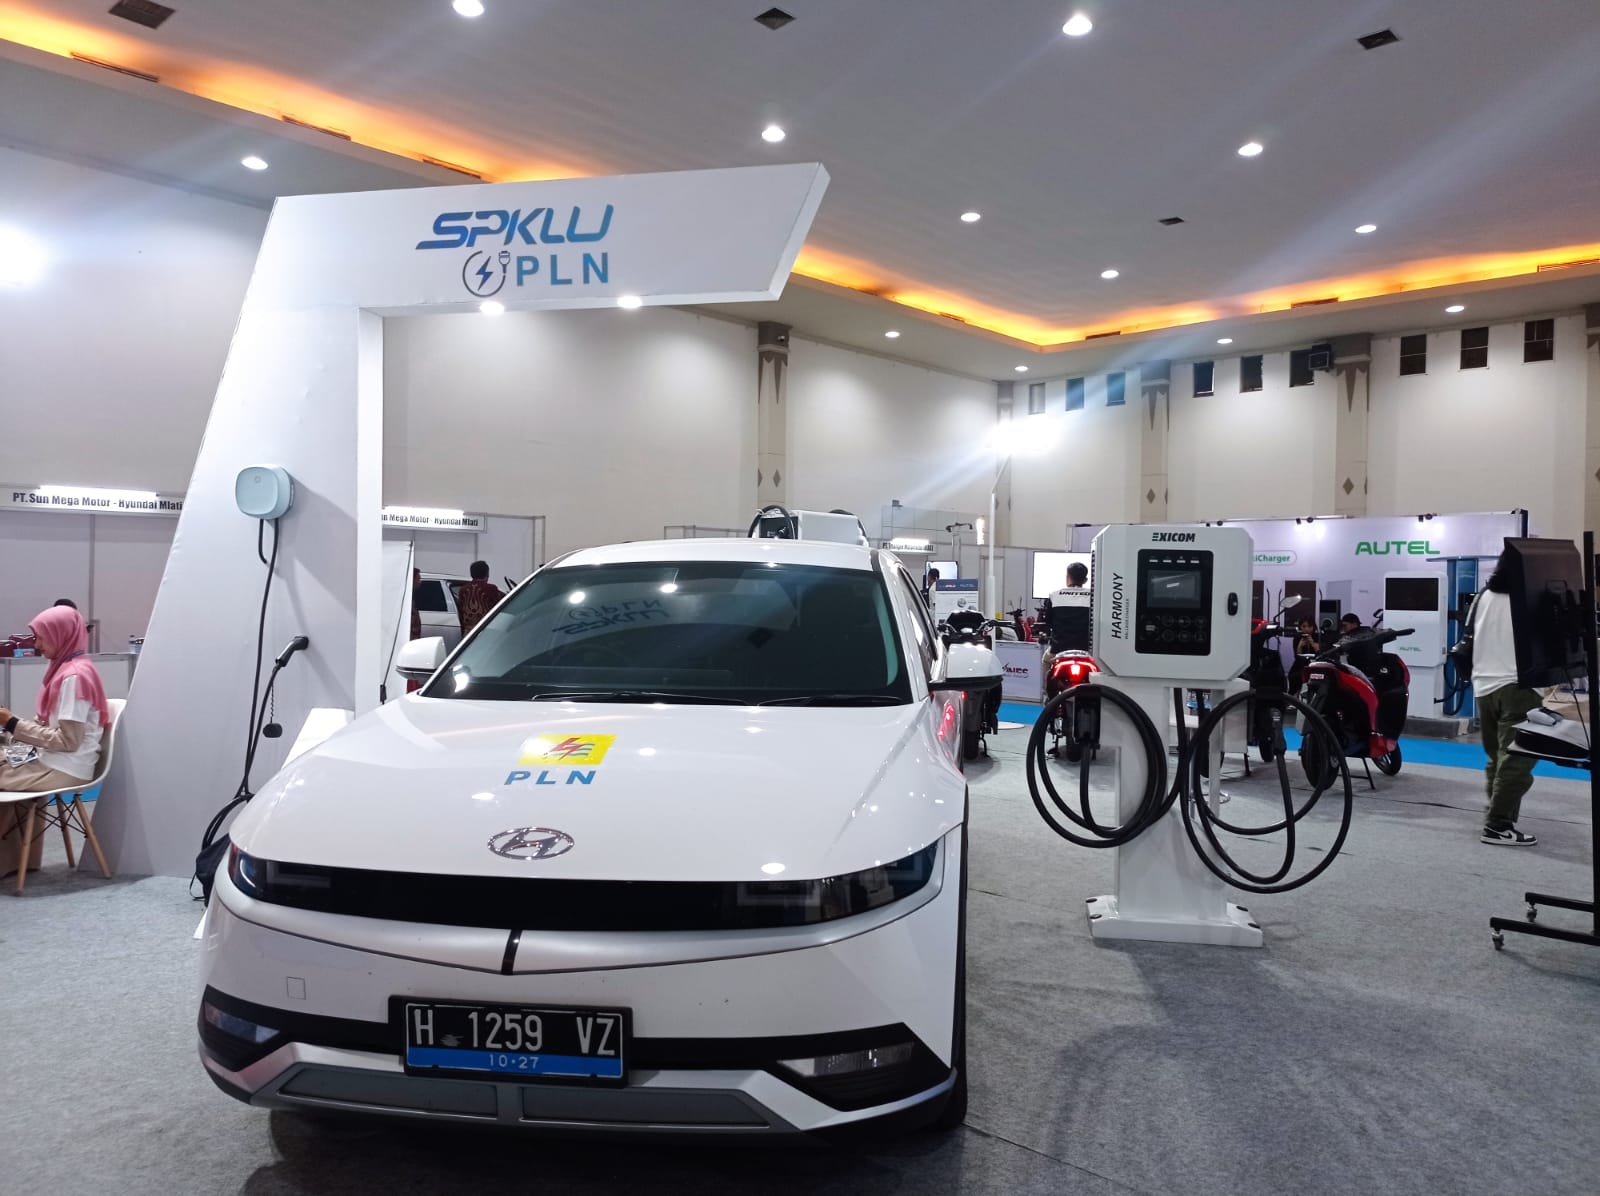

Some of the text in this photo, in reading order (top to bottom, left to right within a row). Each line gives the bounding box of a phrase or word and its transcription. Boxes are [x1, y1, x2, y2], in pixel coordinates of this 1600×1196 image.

[416, 204, 614, 250] SPKLU
[516, 252, 609, 287] PLN
[51, 495, 79, 506] Mega
[82, 497, 110, 507] Motor
[119, 499, 157, 510] Hyundai
[1152, 532, 1196, 543] EXICOM
[1355, 540, 1441, 556] AUTEL
[1111, 572, 1123, 639] HARMONY
[504, 770, 597, 786] PLN
[414, 1009, 616, 1056] H 1259 VZ
